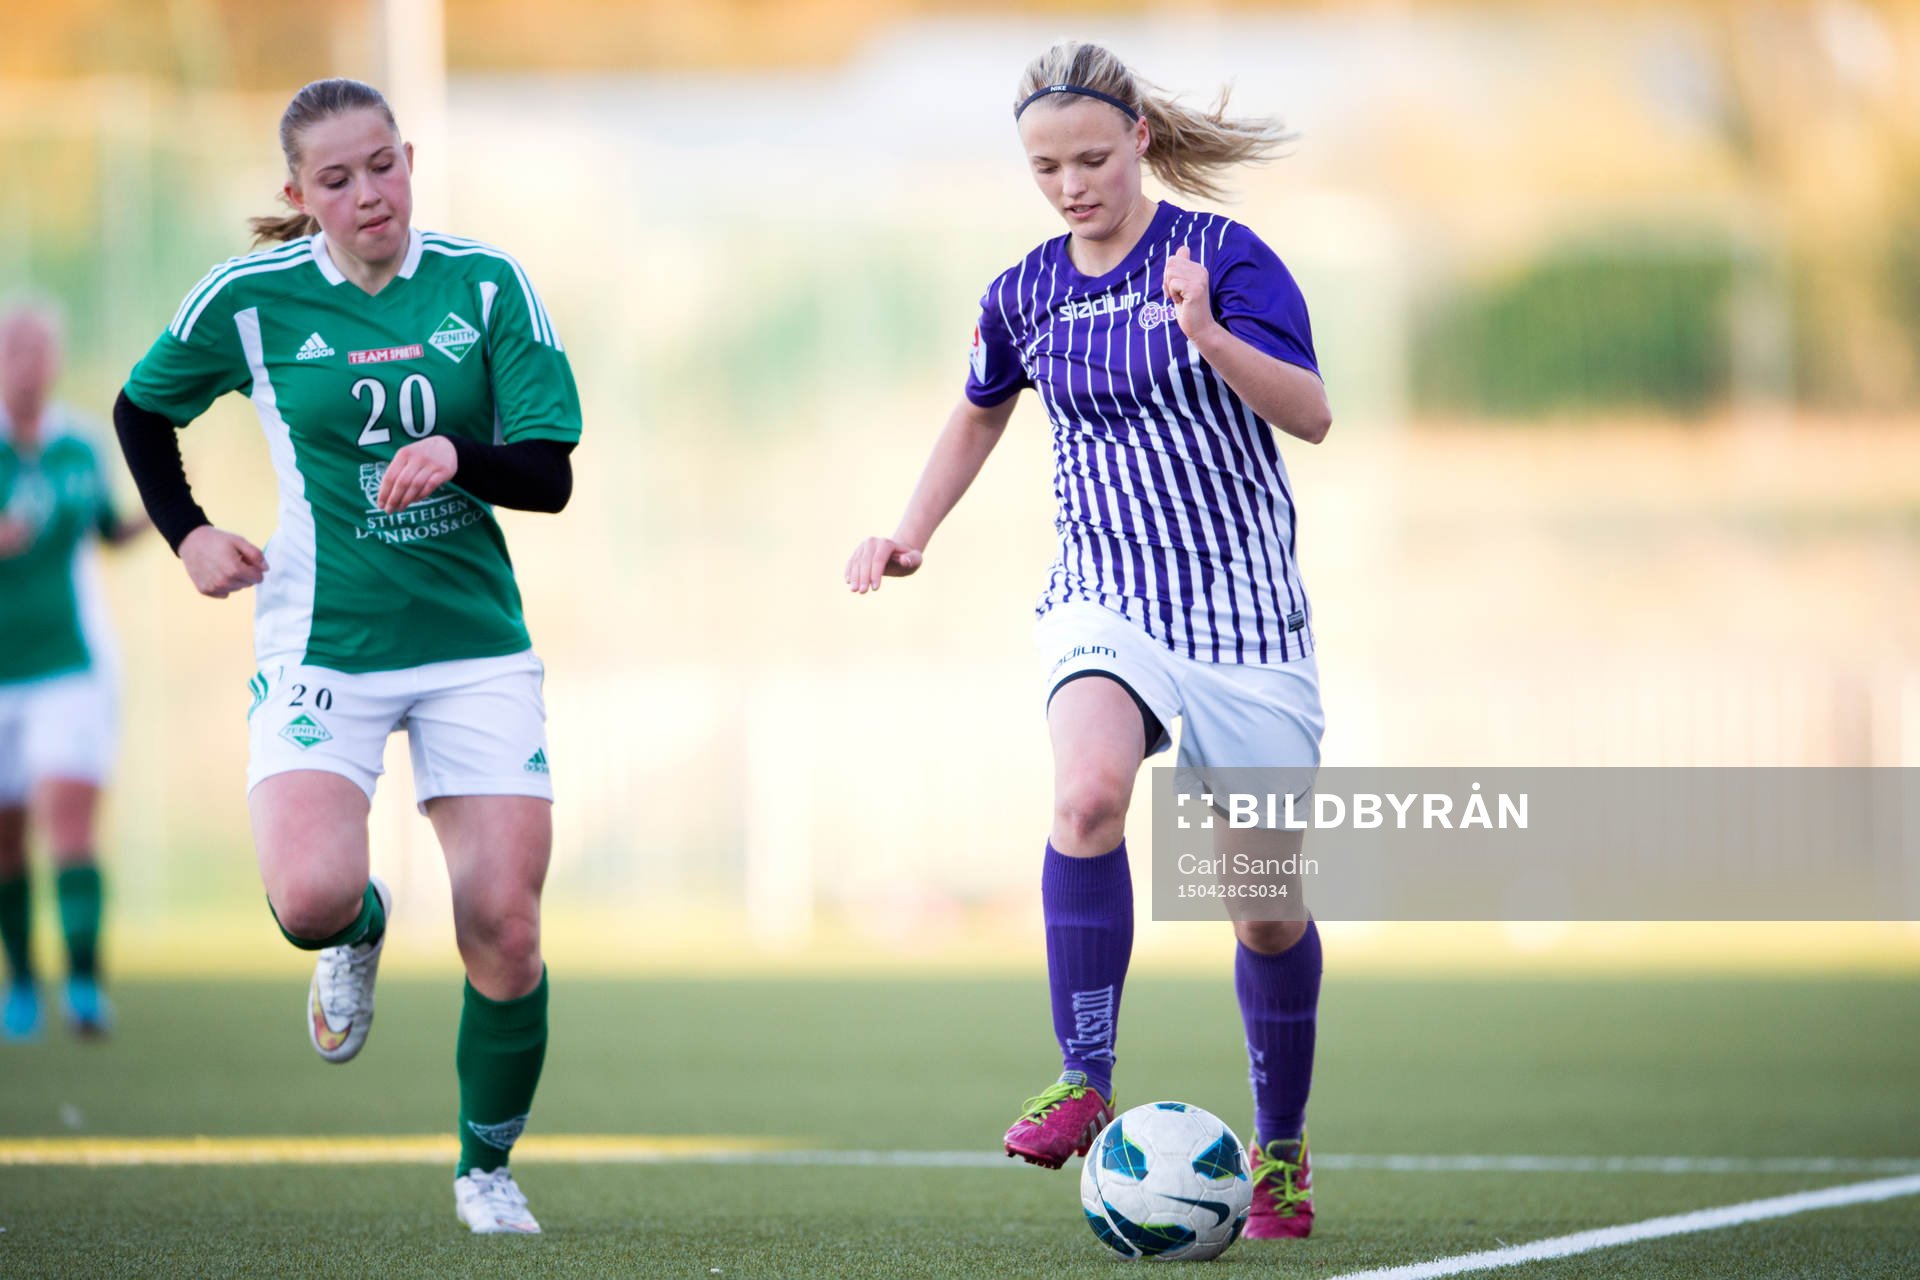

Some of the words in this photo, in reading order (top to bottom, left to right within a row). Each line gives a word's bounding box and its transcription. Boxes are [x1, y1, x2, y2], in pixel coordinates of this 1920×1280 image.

[1059, 292, 1141, 322] stadium
[434, 331, 475, 344] ZENITH
[296, 347, 335, 360] adidas
[350, 349, 390, 364] TEAM
[350, 373, 437, 447] 20
[367, 499, 469, 529] STIFTELSEN
[288, 683, 333, 711] 20
[286, 727, 326, 738] ZENITH
